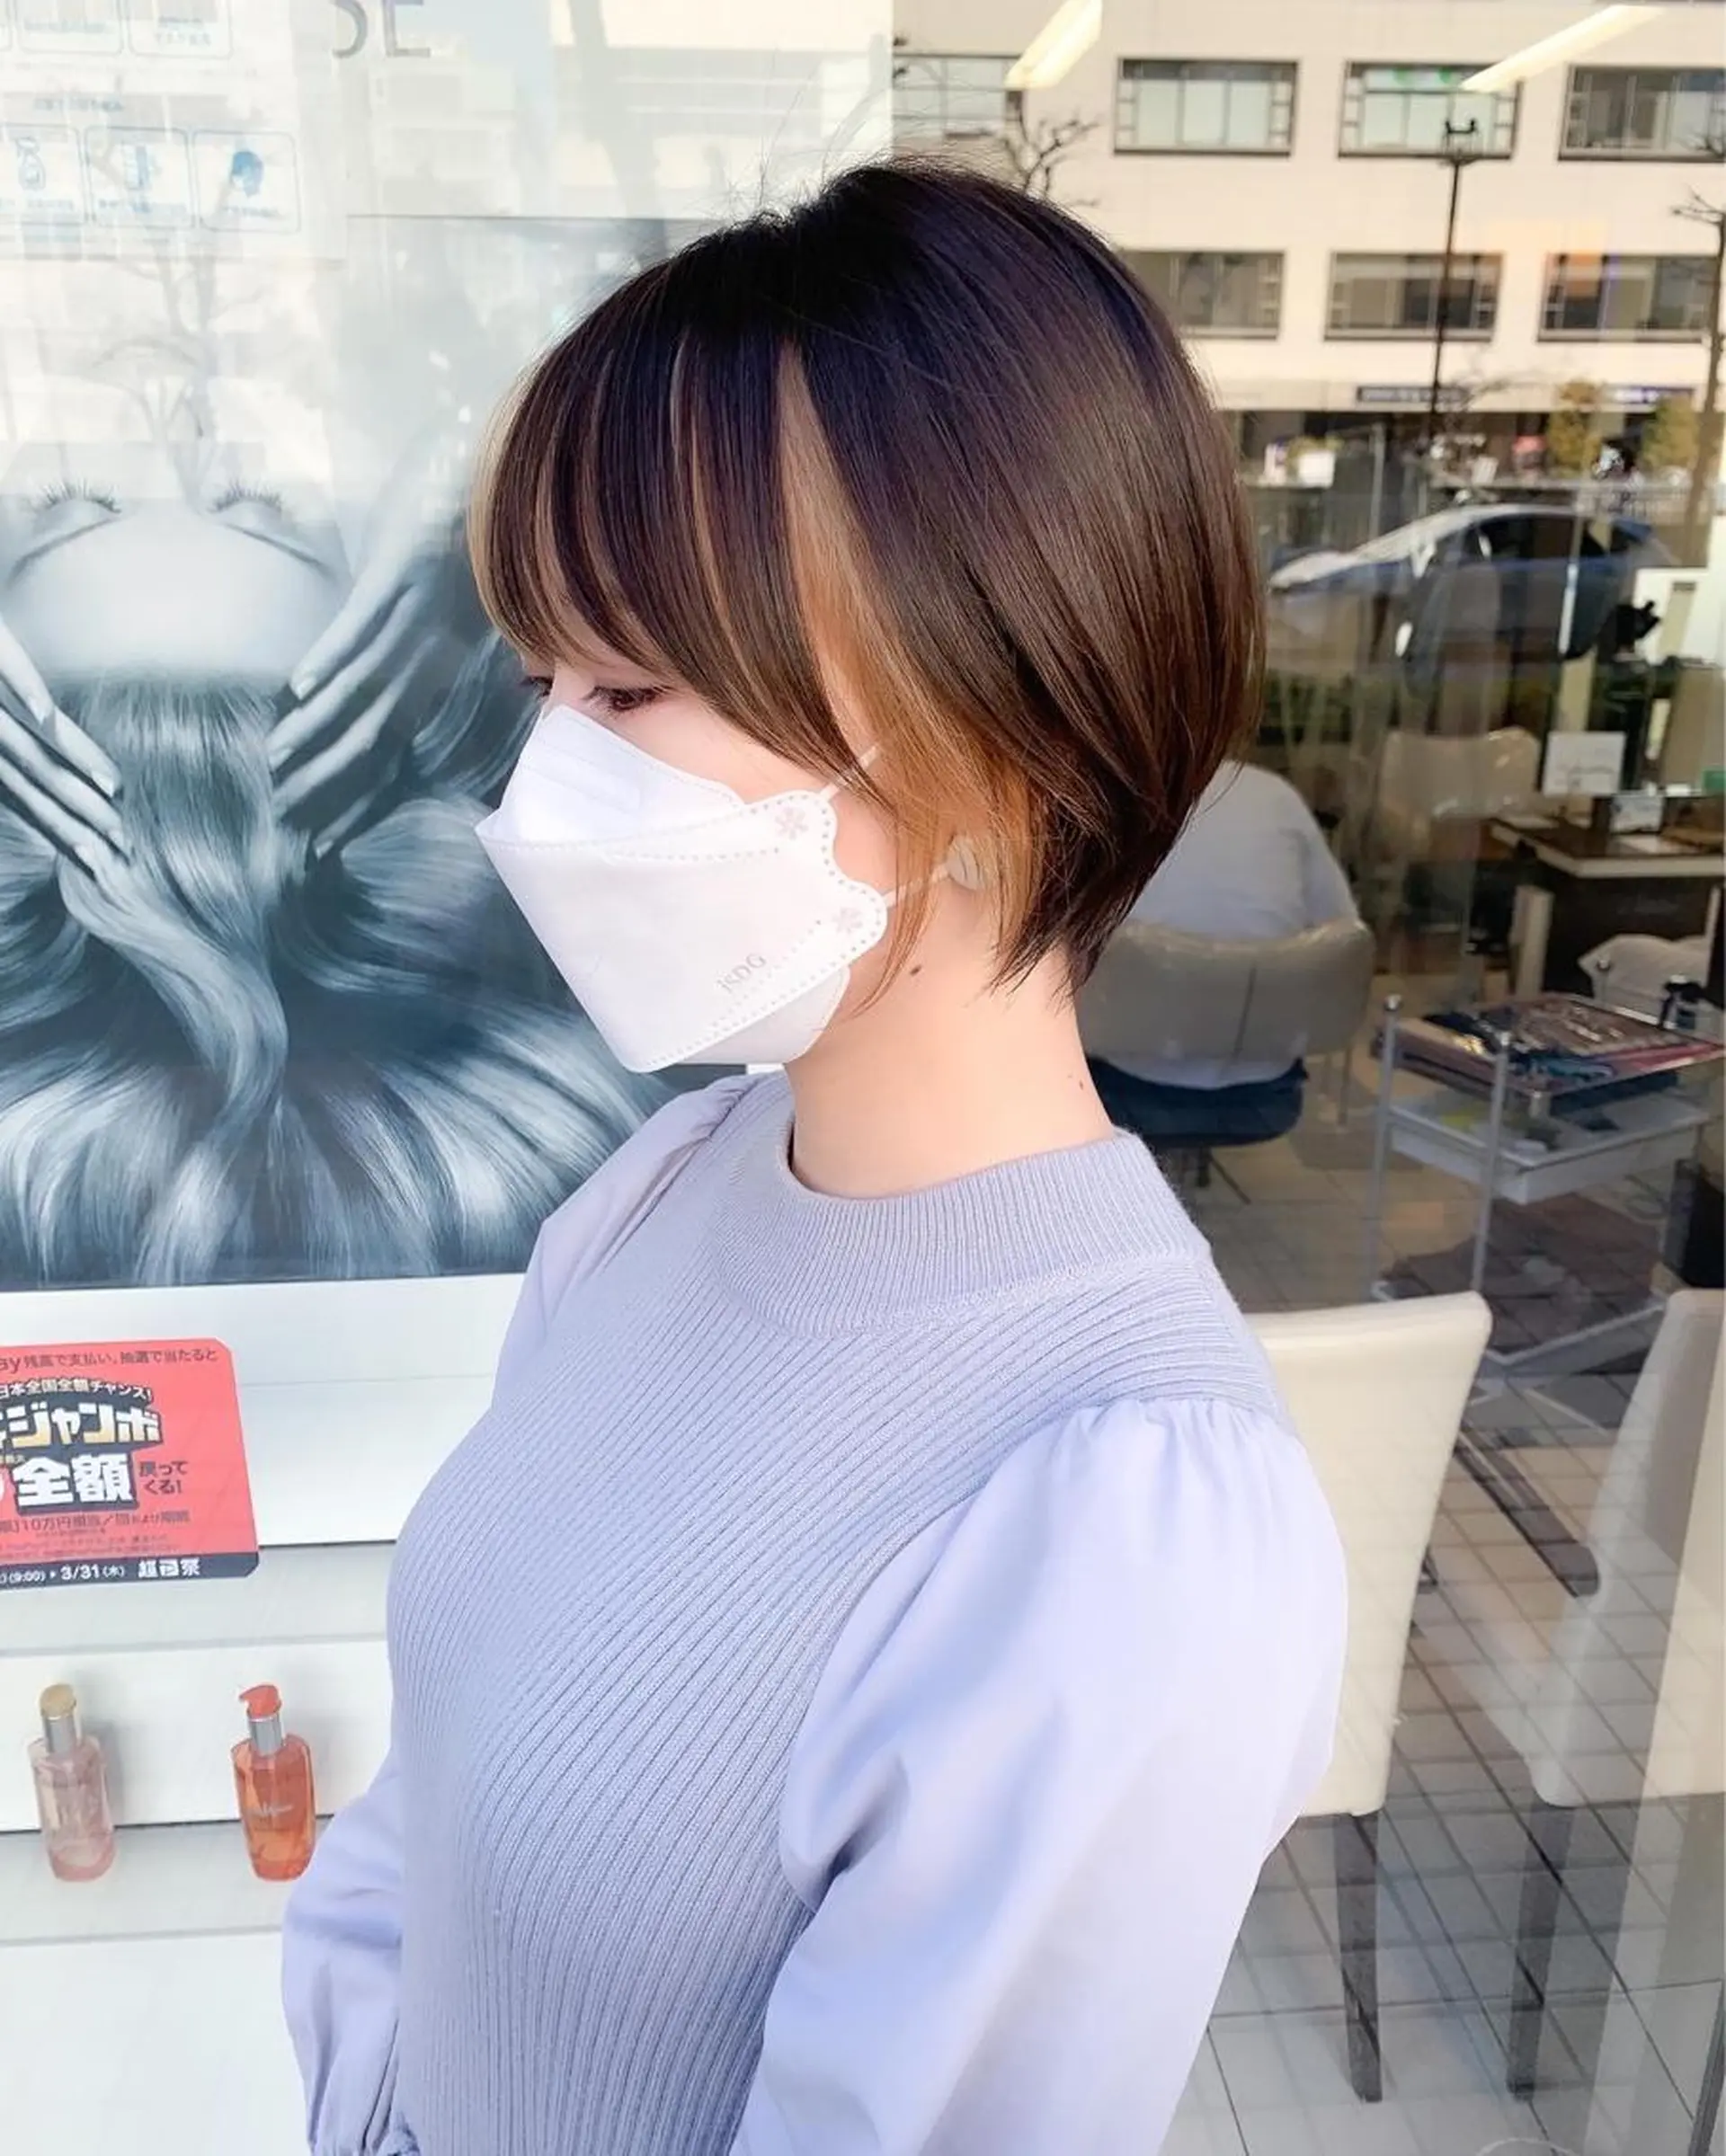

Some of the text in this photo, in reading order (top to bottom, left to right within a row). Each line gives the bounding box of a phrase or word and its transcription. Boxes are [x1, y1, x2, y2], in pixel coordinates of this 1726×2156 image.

[0, 1401, 162, 1449] ジャンボ
[12, 1452, 134, 1506] 全額
